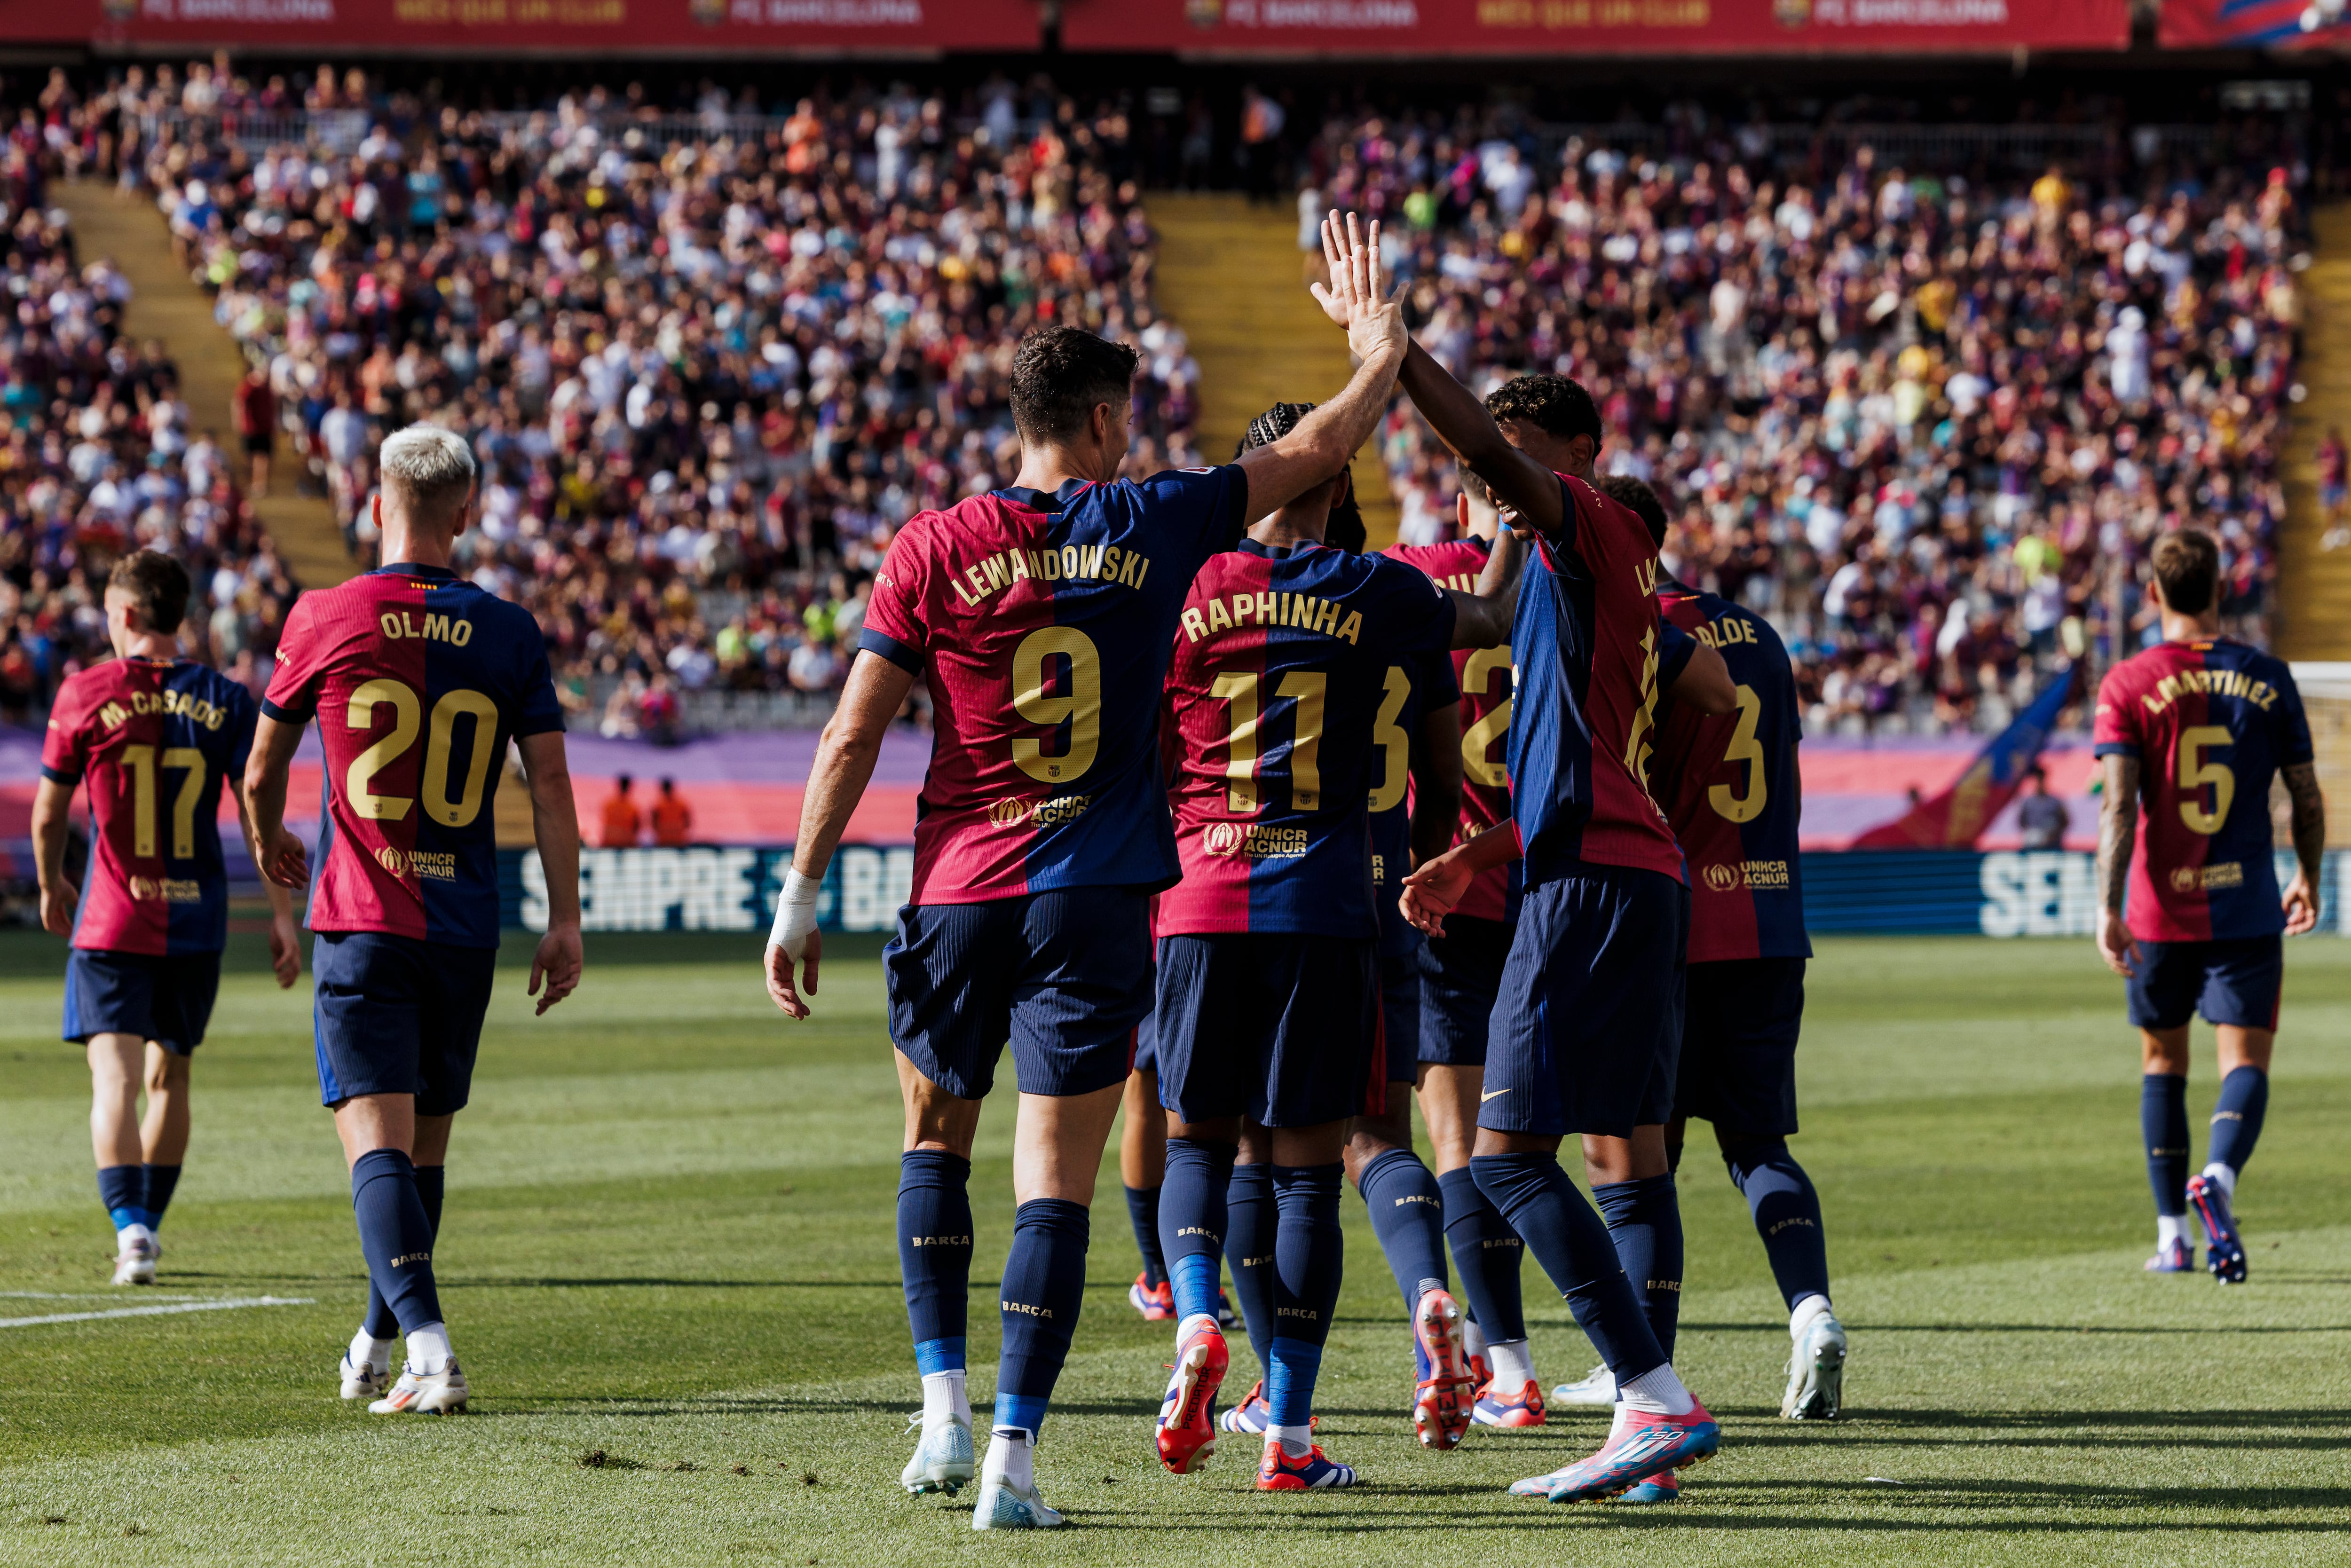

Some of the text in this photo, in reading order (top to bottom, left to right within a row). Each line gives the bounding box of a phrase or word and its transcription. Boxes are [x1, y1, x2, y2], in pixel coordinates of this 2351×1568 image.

[952, 544, 1149, 607] LEWANDOWSKI
[1181, 592, 1363, 646] RAPHINHA
[380, 612, 473, 646] OLMO
[1685, 617, 1758, 649] ALDE
[1011, 626, 1101, 783] 9
[1207, 671, 1327, 812] 11
[346, 678, 498, 827] 20
[1708, 684, 1767, 823] 3
[2178, 725, 2235, 835] 5
[120, 744, 206, 859] 17
[1246, 825, 1307, 841] UNHCR
[1244, 839, 1306, 853] ACNUR
[408, 851, 455, 865] UNHCR
[1740, 860, 1788, 872] UNHCR
[413, 863, 455, 878] ACNUR
[1744, 873, 1789, 884] ACNUR
[1395, 1195, 1441, 1210] BARÇA
[1177, 1227, 1219, 1245] BARÇA
[1769, 1217, 1815, 1236] BARÇA
[913, 1235, 970, 1247] BARÇA
[391, 1252, 430, 1268] BARÇA
[1002, 1300, 1053, 1319] BARÇA
[1278, 1308, 1317, 1320] BARÇA
[1183, 1366, 1212, 1430] PREDATOR
